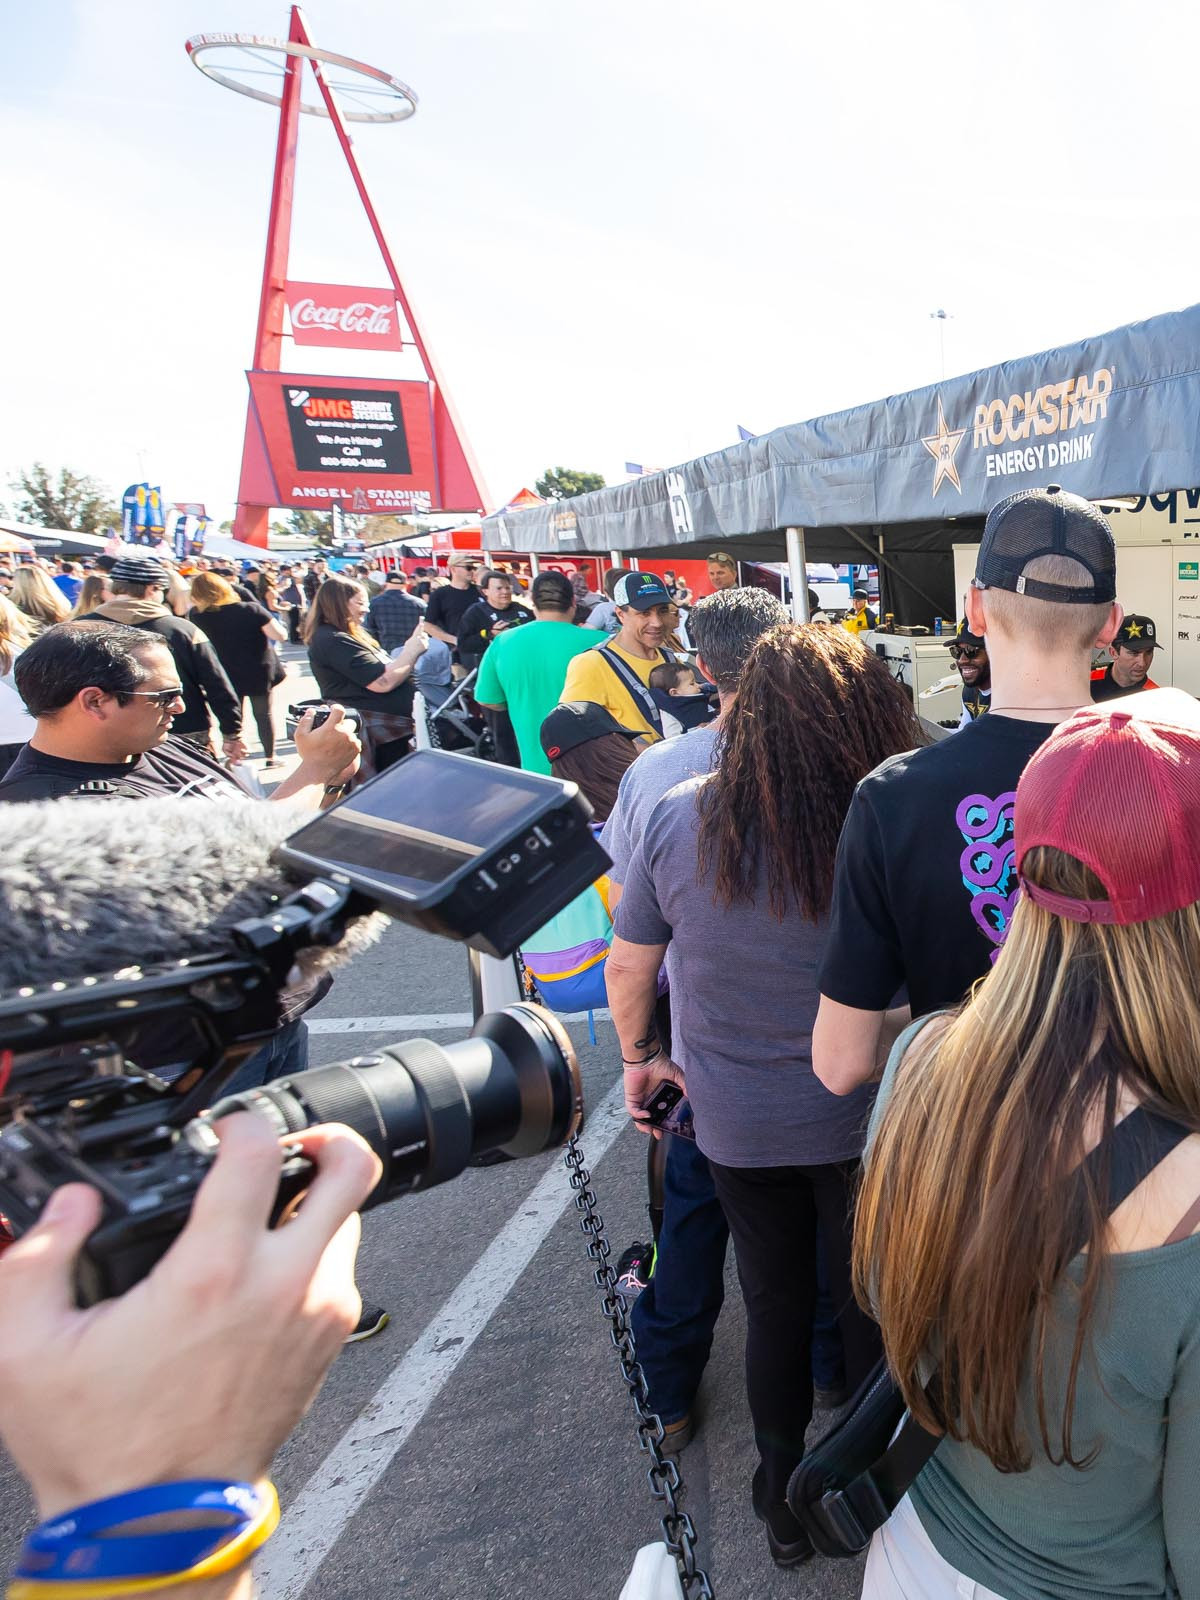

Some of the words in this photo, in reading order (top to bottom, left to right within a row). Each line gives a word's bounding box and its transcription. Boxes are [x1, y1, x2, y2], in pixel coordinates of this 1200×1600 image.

[291, 298, 391, 334] Coca-Cola
[304, 397, 352, 419] JMG
[973, 368, 1113, 449] ROCKSTAR
[352, 411, 394, 421] SYSTEMS
[316, 434, 333, 445] We
[334, 435, 350, 446] Are
[351, 436, 383, 448] Hiring!
[342, 446, 361, 456] Call
[985, 443, 1045, 477] ENERGY
[1048, 432, 1095, 467] DRINK
[292, 486, 352, 499] ANGEL
[367, 489, 431, 500] STADIUM
[1178, 631, 1189, 640] RK
